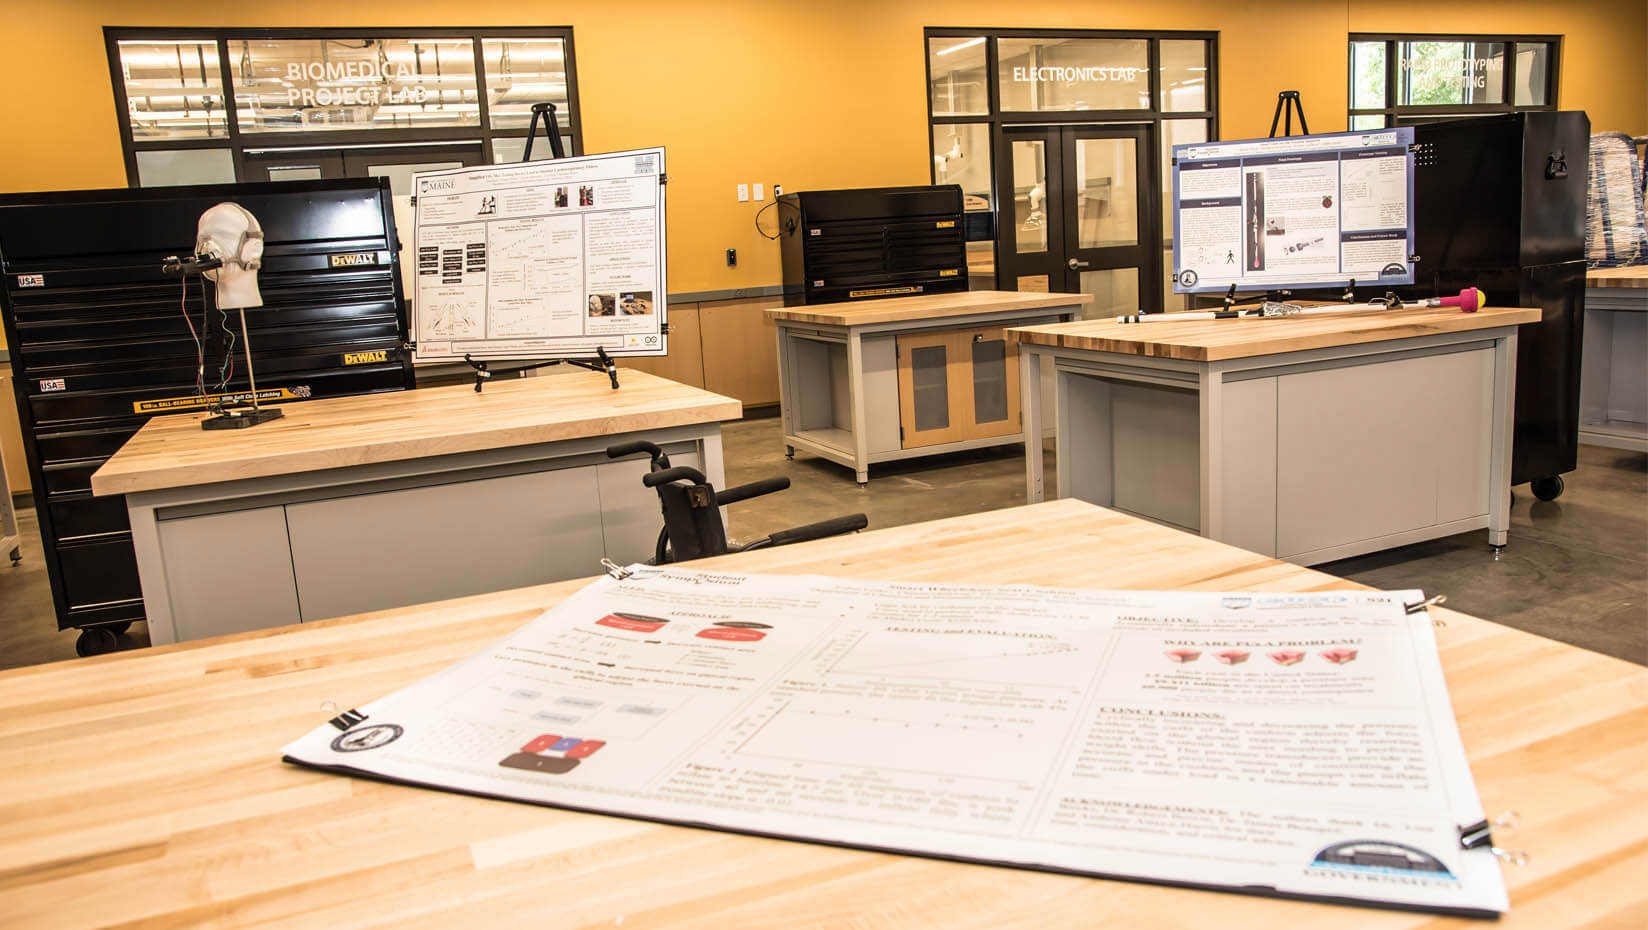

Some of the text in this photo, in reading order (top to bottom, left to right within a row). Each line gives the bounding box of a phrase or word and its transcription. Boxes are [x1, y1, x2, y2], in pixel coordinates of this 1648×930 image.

[287, 61, 419, 81] BIOMEDICAL
[1013, 66, 1136, 81] ELECTRONICS LAB
[287, 86, 426, 106] PROJECT LAB
[429, 181, 456, 192] MAINE
[19, 277, 36, 286] USA
[41, 382, 57, 391] USA
